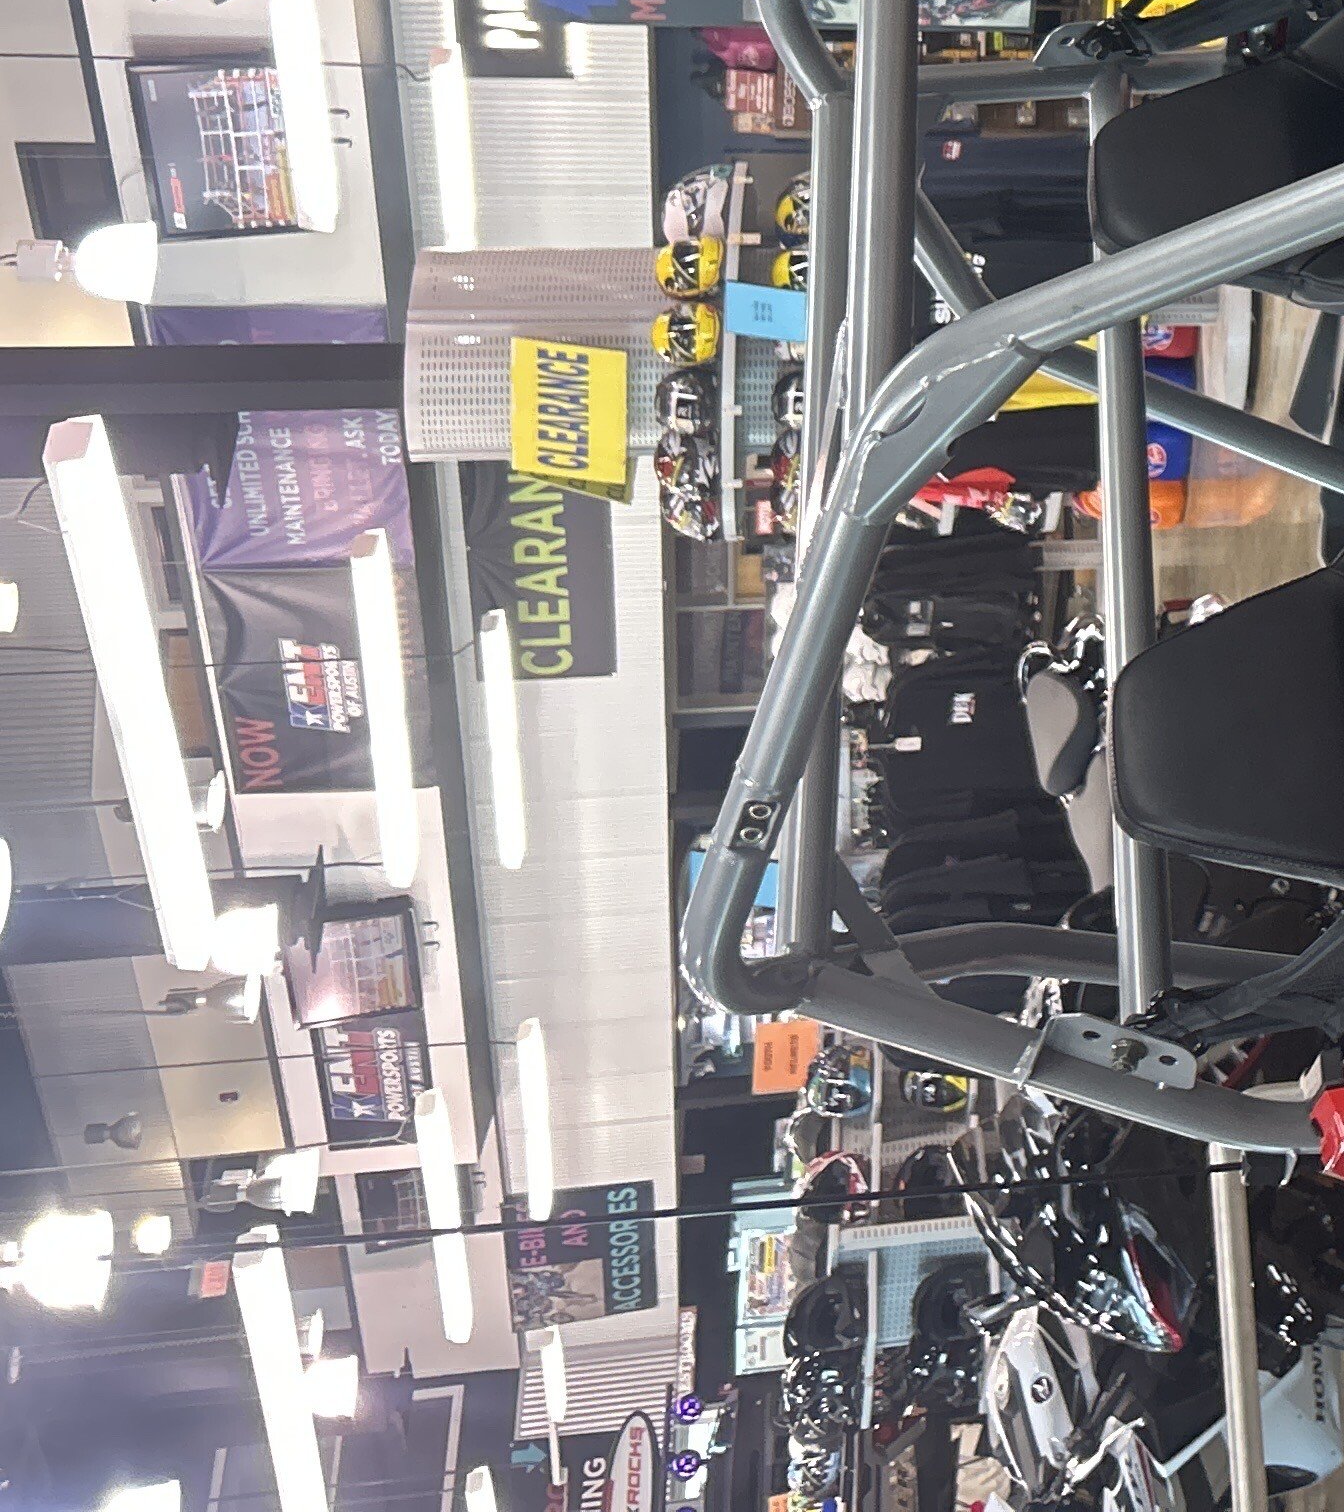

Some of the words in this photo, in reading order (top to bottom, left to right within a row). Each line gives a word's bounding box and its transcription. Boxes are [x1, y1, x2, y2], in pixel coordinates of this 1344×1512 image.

[341, 417, 366, 449] ASK
[375, 409, 400, 465] TODAY
[537, 348, 589, 469] CLEARANCE
[236, 449, 270, 537] UNLIMITED
[268, 428, 306, 545] MAINTENANCE
[321, 643, 351, 733] POWERSPORTS
[235, 717, 283, 789] NOW
[319, 1027, 384, 1120] KENT
[377, 1029, 408, 1121] POWERSPORTS
[607, 1187, 642, 1310] ACCESSORES
[580, 1457, 607, 1512] ING
